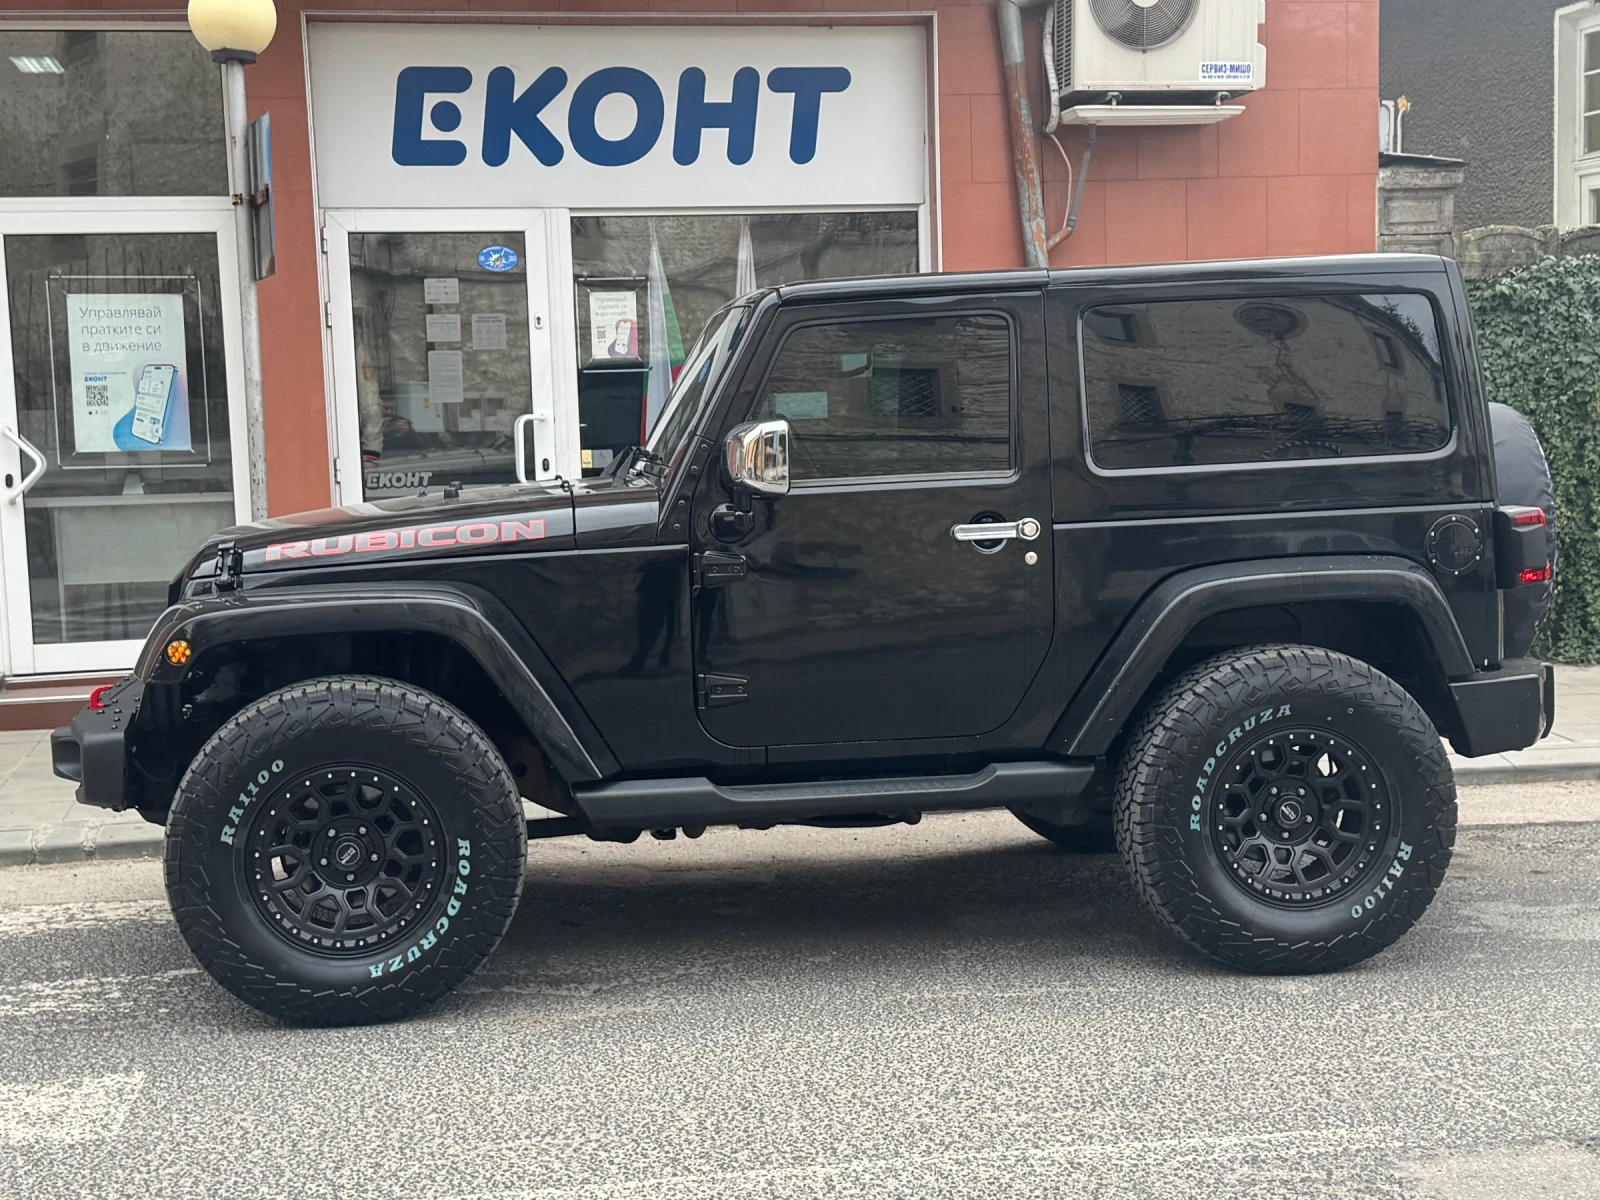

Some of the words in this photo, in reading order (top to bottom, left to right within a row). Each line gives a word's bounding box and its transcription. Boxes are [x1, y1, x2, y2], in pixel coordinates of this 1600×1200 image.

[1201, 63, 1251, 74] СЕРВИЗ-МИШО
[392, 66, 851, 167] ЕКОНТ
[79, 306, 162, 320] Управлявай
[81, 325, 142, 337] пратките
[146, 325, 161, 335] си
[82, 342, 90, 352] в
[94, 341, 162, 353] движение
[366, 471, 433, 490] ЕКОНТ
[265, 519, 546, 561] RUBICON
[1190, 704, 1291, 831] ROADCRUZA
[220, 759, 285, 845] RA1100
[1350, 841, 1413, 918] RA1100
[368, 838, 471, 978] ROADCRUZA
